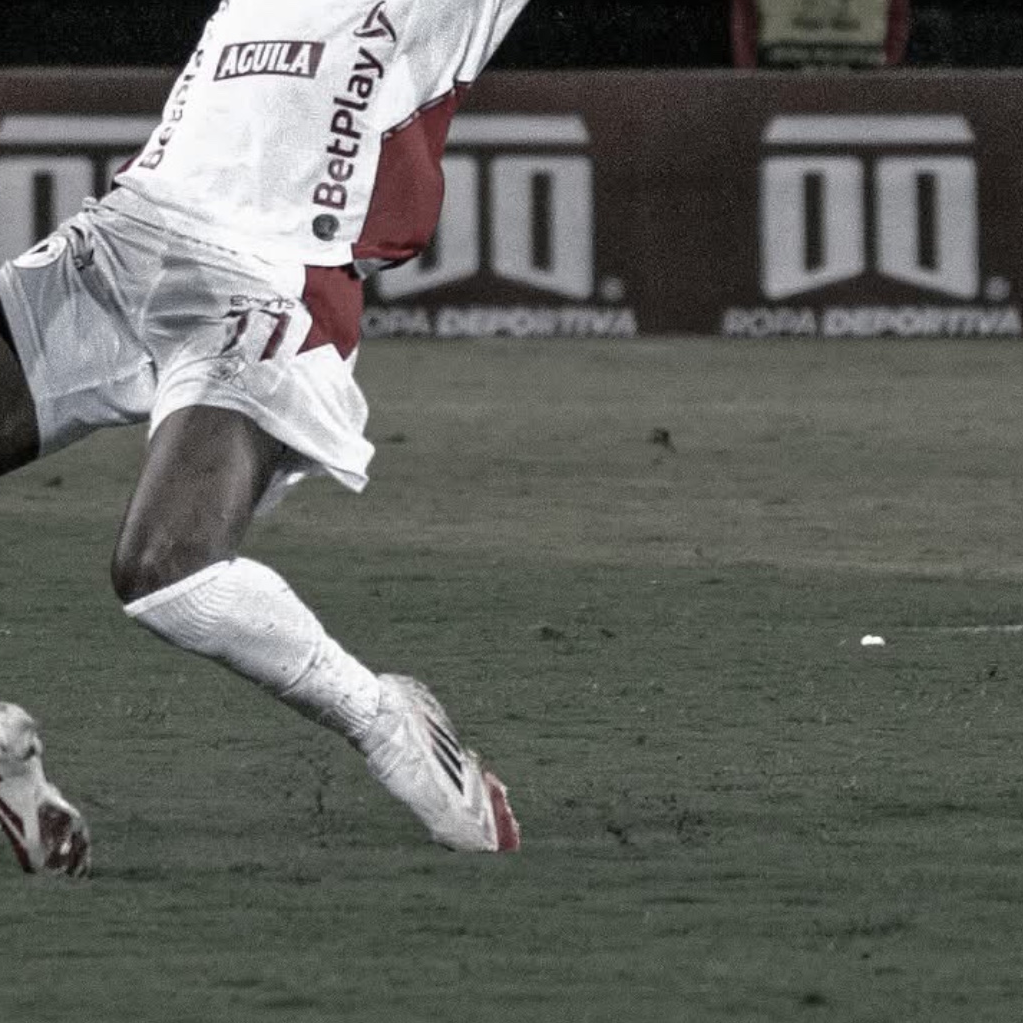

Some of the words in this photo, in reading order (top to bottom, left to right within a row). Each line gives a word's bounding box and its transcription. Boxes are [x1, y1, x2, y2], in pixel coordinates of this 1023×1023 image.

[219, 42, 313, 77] AGUILA
[312, 47, 386, 211] BetPlay
[360, 307, 430, 337] OPA
